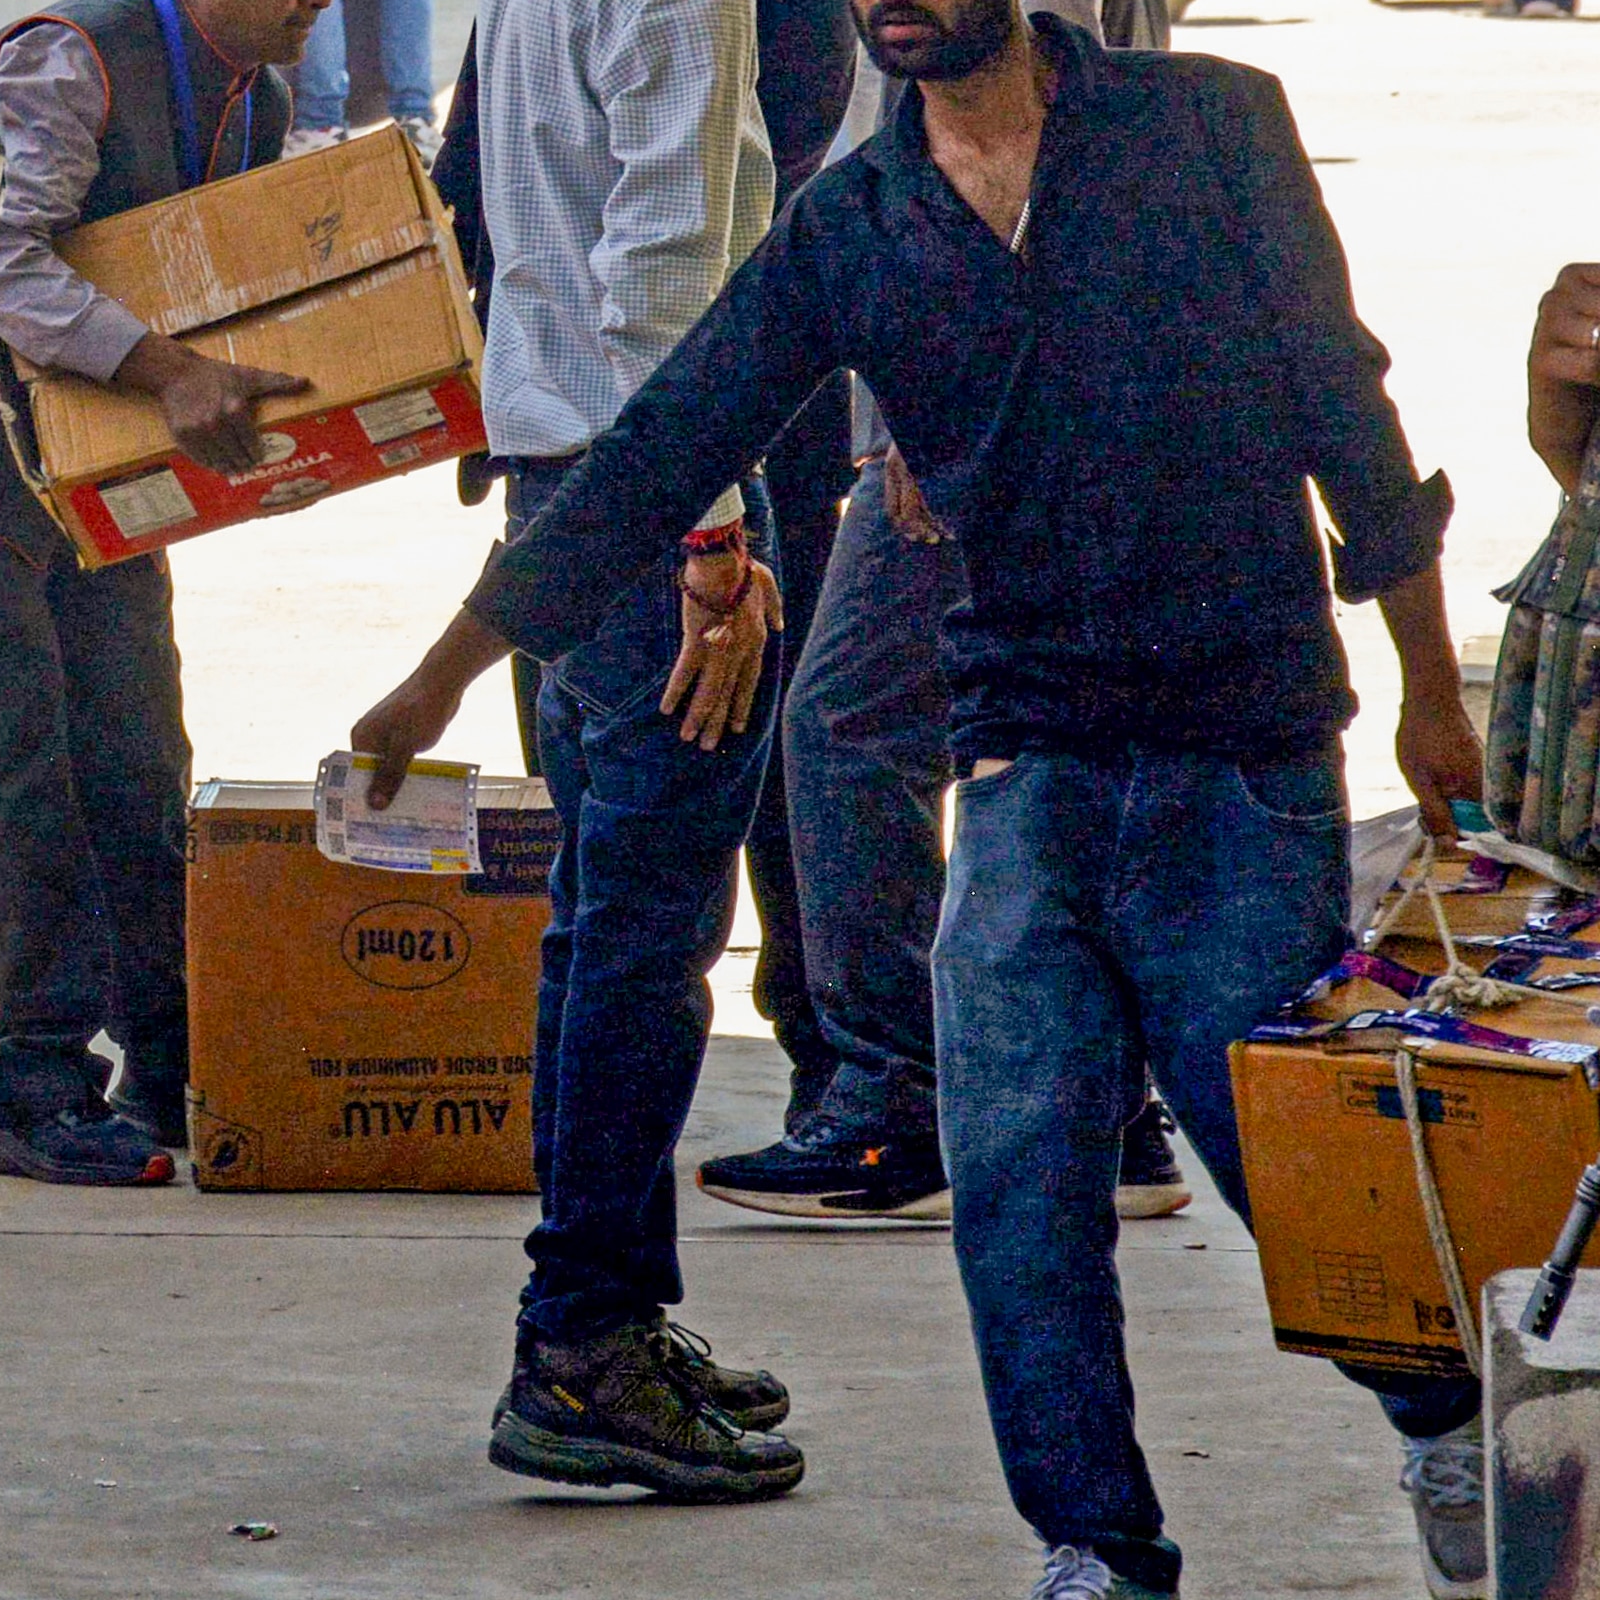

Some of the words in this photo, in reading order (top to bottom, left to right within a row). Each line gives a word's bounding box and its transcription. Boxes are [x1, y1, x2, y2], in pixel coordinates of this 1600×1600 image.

[356, 927, 458, 962] 120ml
[343, 1099, 422, 1138] ALU
[432, 1097, 513, 1136] ALU
